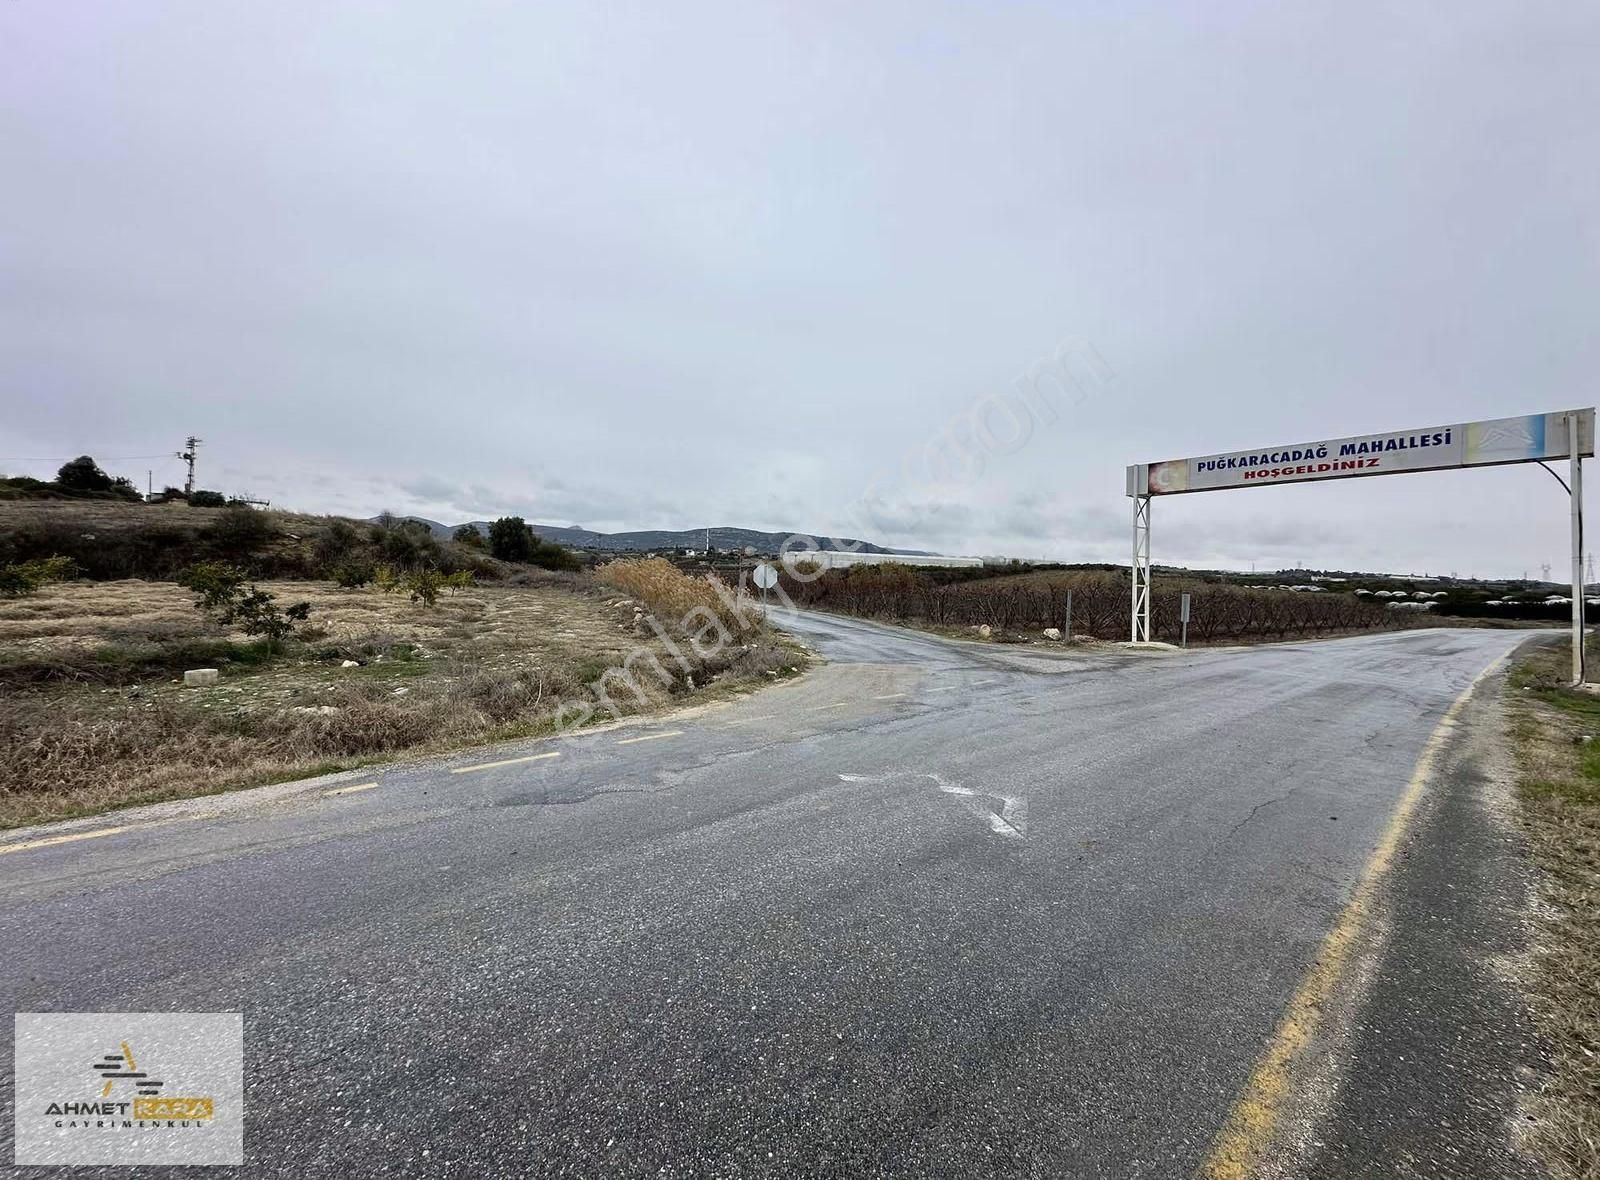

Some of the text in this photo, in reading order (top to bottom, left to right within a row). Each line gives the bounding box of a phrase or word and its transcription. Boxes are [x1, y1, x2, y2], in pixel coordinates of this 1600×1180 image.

[1198, 429, 1451, 472] PUĞKARACADAĞ MAHALLESİ
[1244, 457, 1380, 479] HOŞGELDİNİZ
